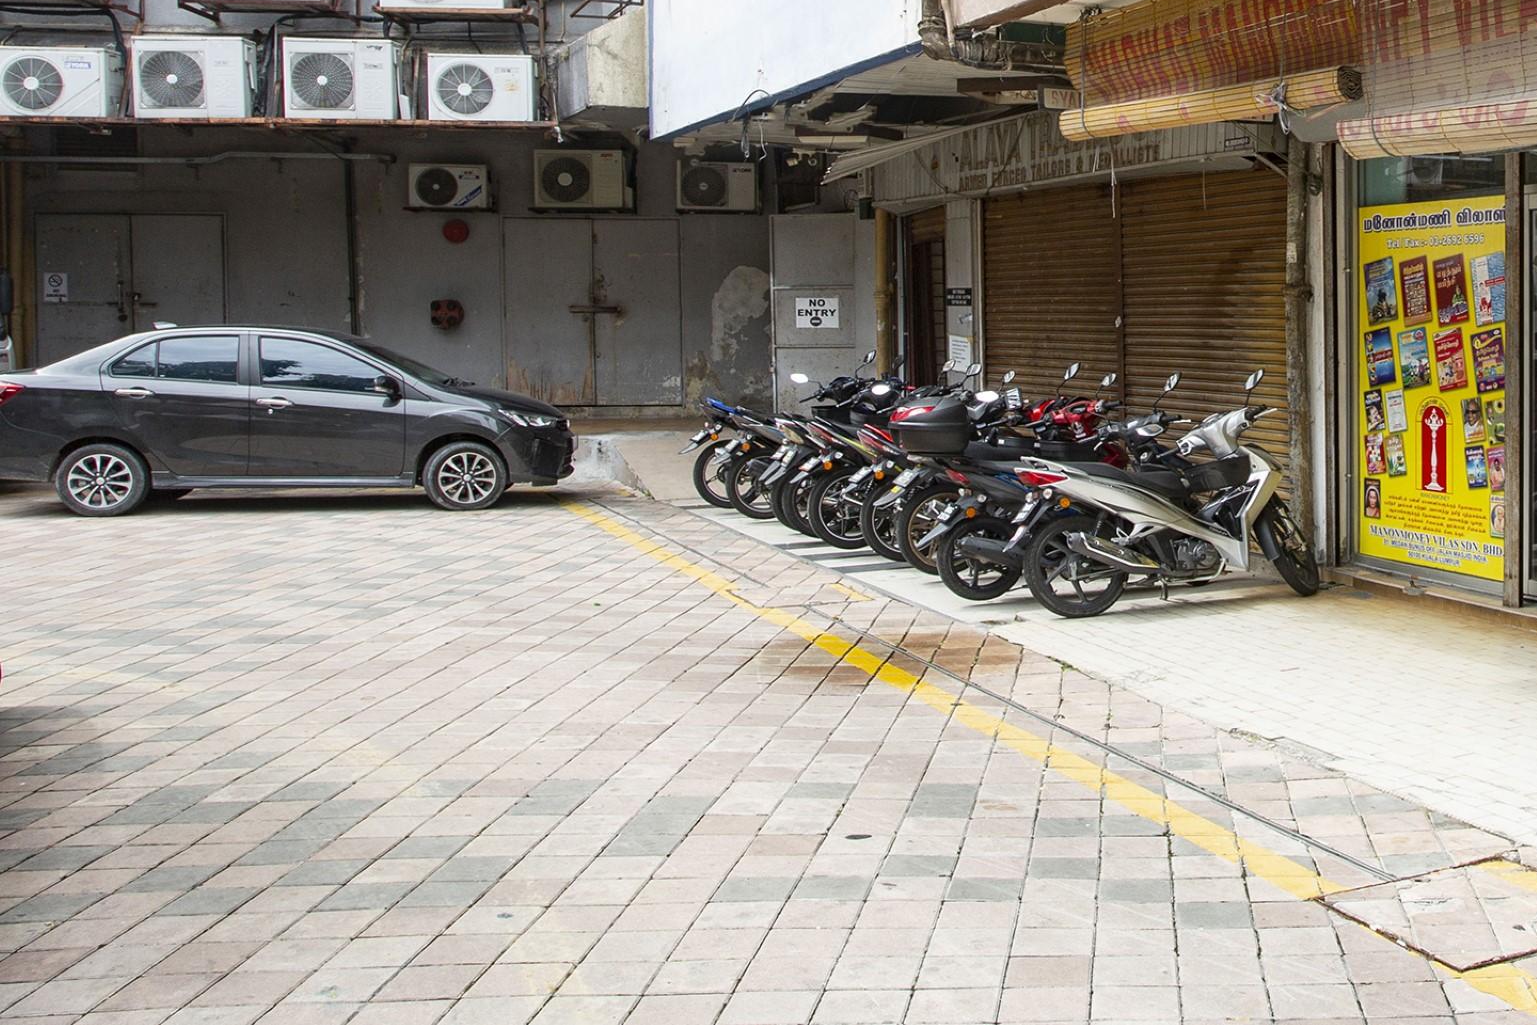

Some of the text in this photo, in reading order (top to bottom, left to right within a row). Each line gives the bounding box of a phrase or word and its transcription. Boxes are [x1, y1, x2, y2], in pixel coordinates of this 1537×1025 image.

[1363, 208, 1451, 232] மனோன்மணி
[808, 298, 826, 307] NO
[797, 309, 837, 317] ENTRY
[1370, 525, 1433, 544] MANONMONEY
[1433, 535, 1460, 549] VILAS
